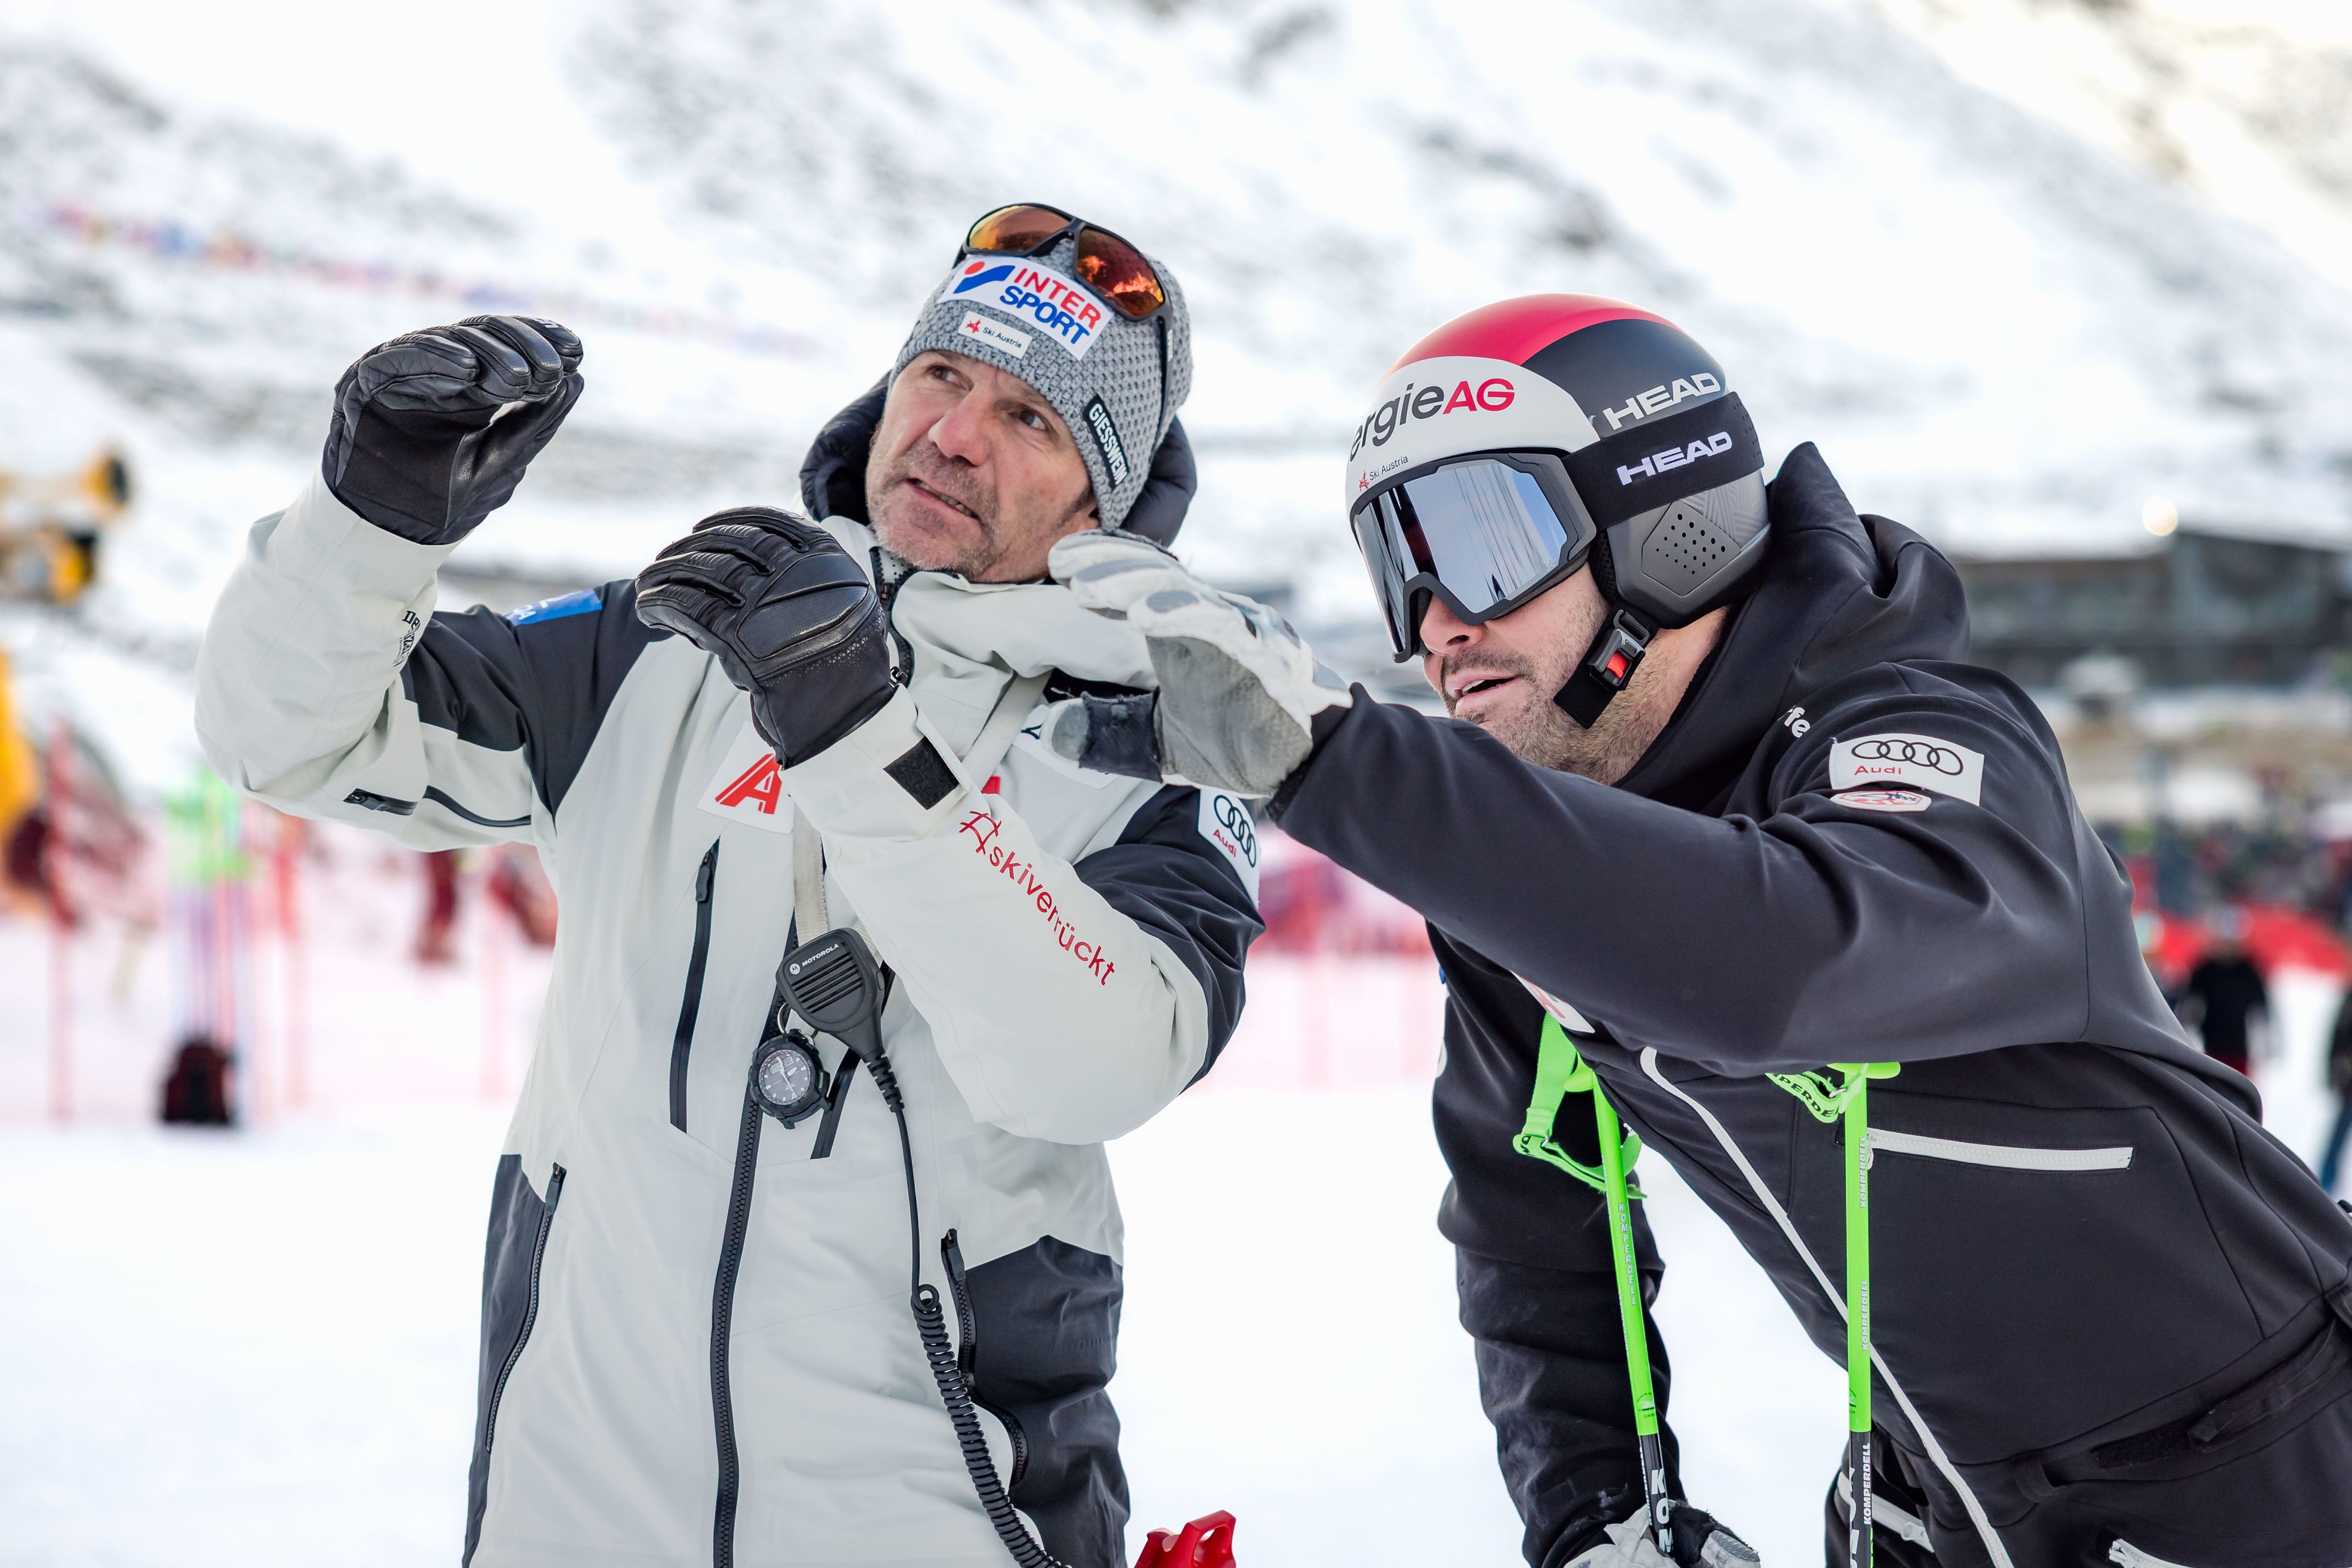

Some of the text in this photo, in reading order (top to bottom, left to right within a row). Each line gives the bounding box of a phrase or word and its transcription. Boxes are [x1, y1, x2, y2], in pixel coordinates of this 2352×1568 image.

[1000, 286, 1090, 344] SPORT
[1014, 268, 1101, 329] INTER
[983, 327, 1022, 348] Ski Austria
[1602, 373, 1721, 430] HEAD
[1369, 455, 1409, 481] Ski Austria
[1616, 431, 1733, 486] HEAD
[1854, 765, 1902, 775] Audi
[1213, 829, 1237, 858] Audi
[802, 944, 839, 967] MOTOROLA
[1618, 1202, 1636, 1305] KOMPERDELL
[1862, 1443, 1872, 1525] KOMPERDELL
